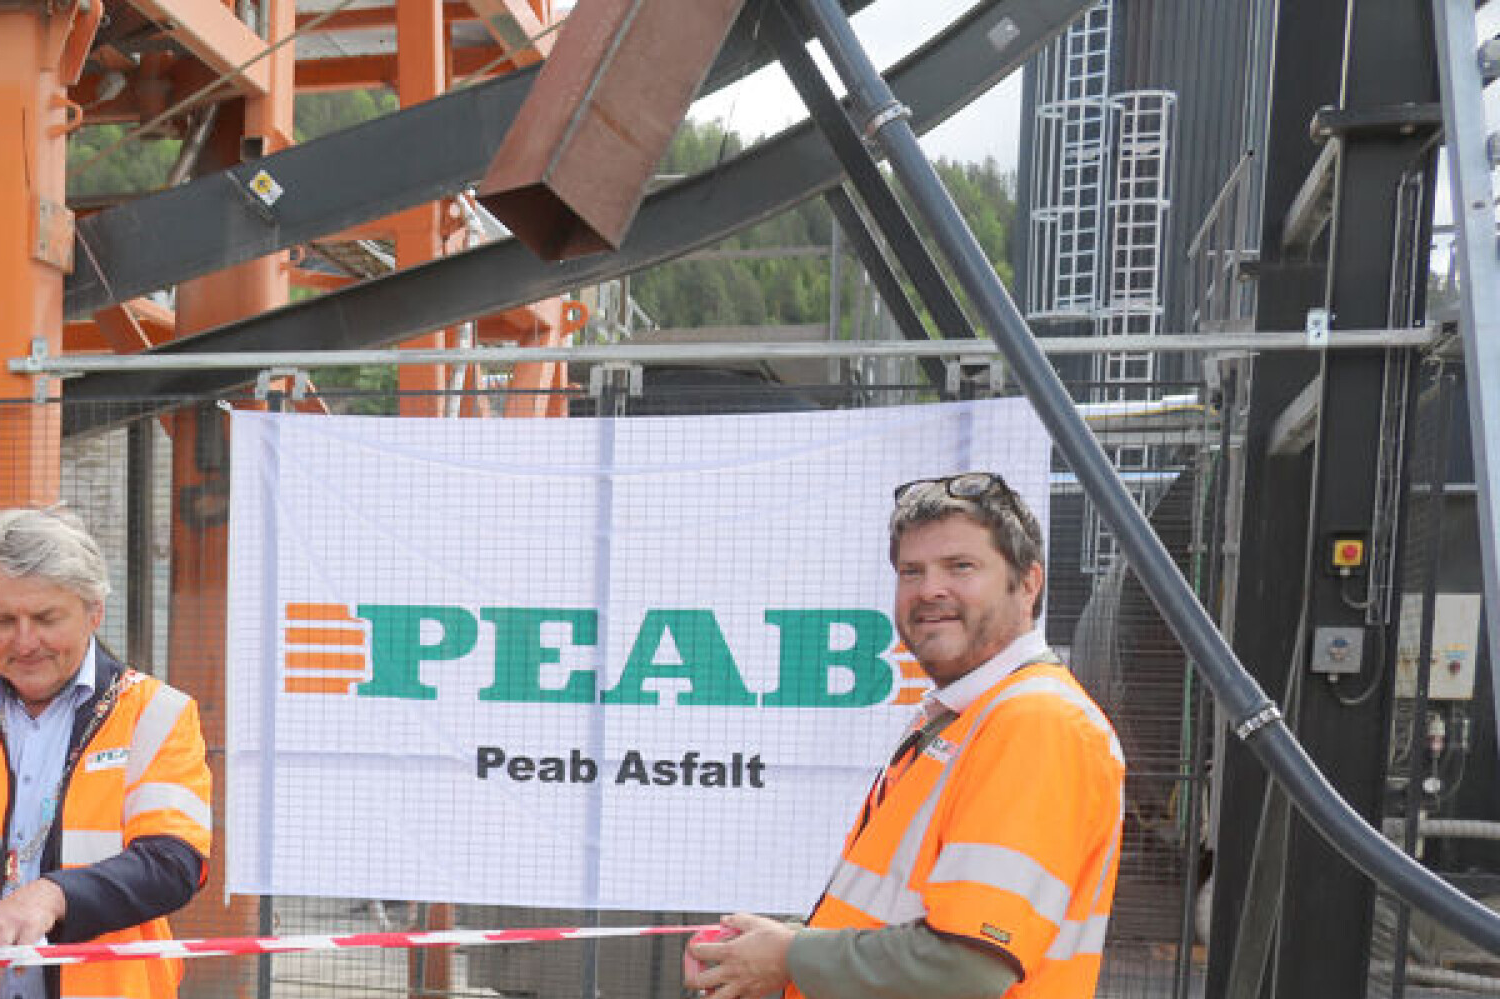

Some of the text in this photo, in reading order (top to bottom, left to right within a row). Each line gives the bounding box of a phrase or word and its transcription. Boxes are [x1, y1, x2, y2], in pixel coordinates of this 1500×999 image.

[357, 603, 894, 708] PEAB
[476, 746, 766, 788] Peab Asfalt
